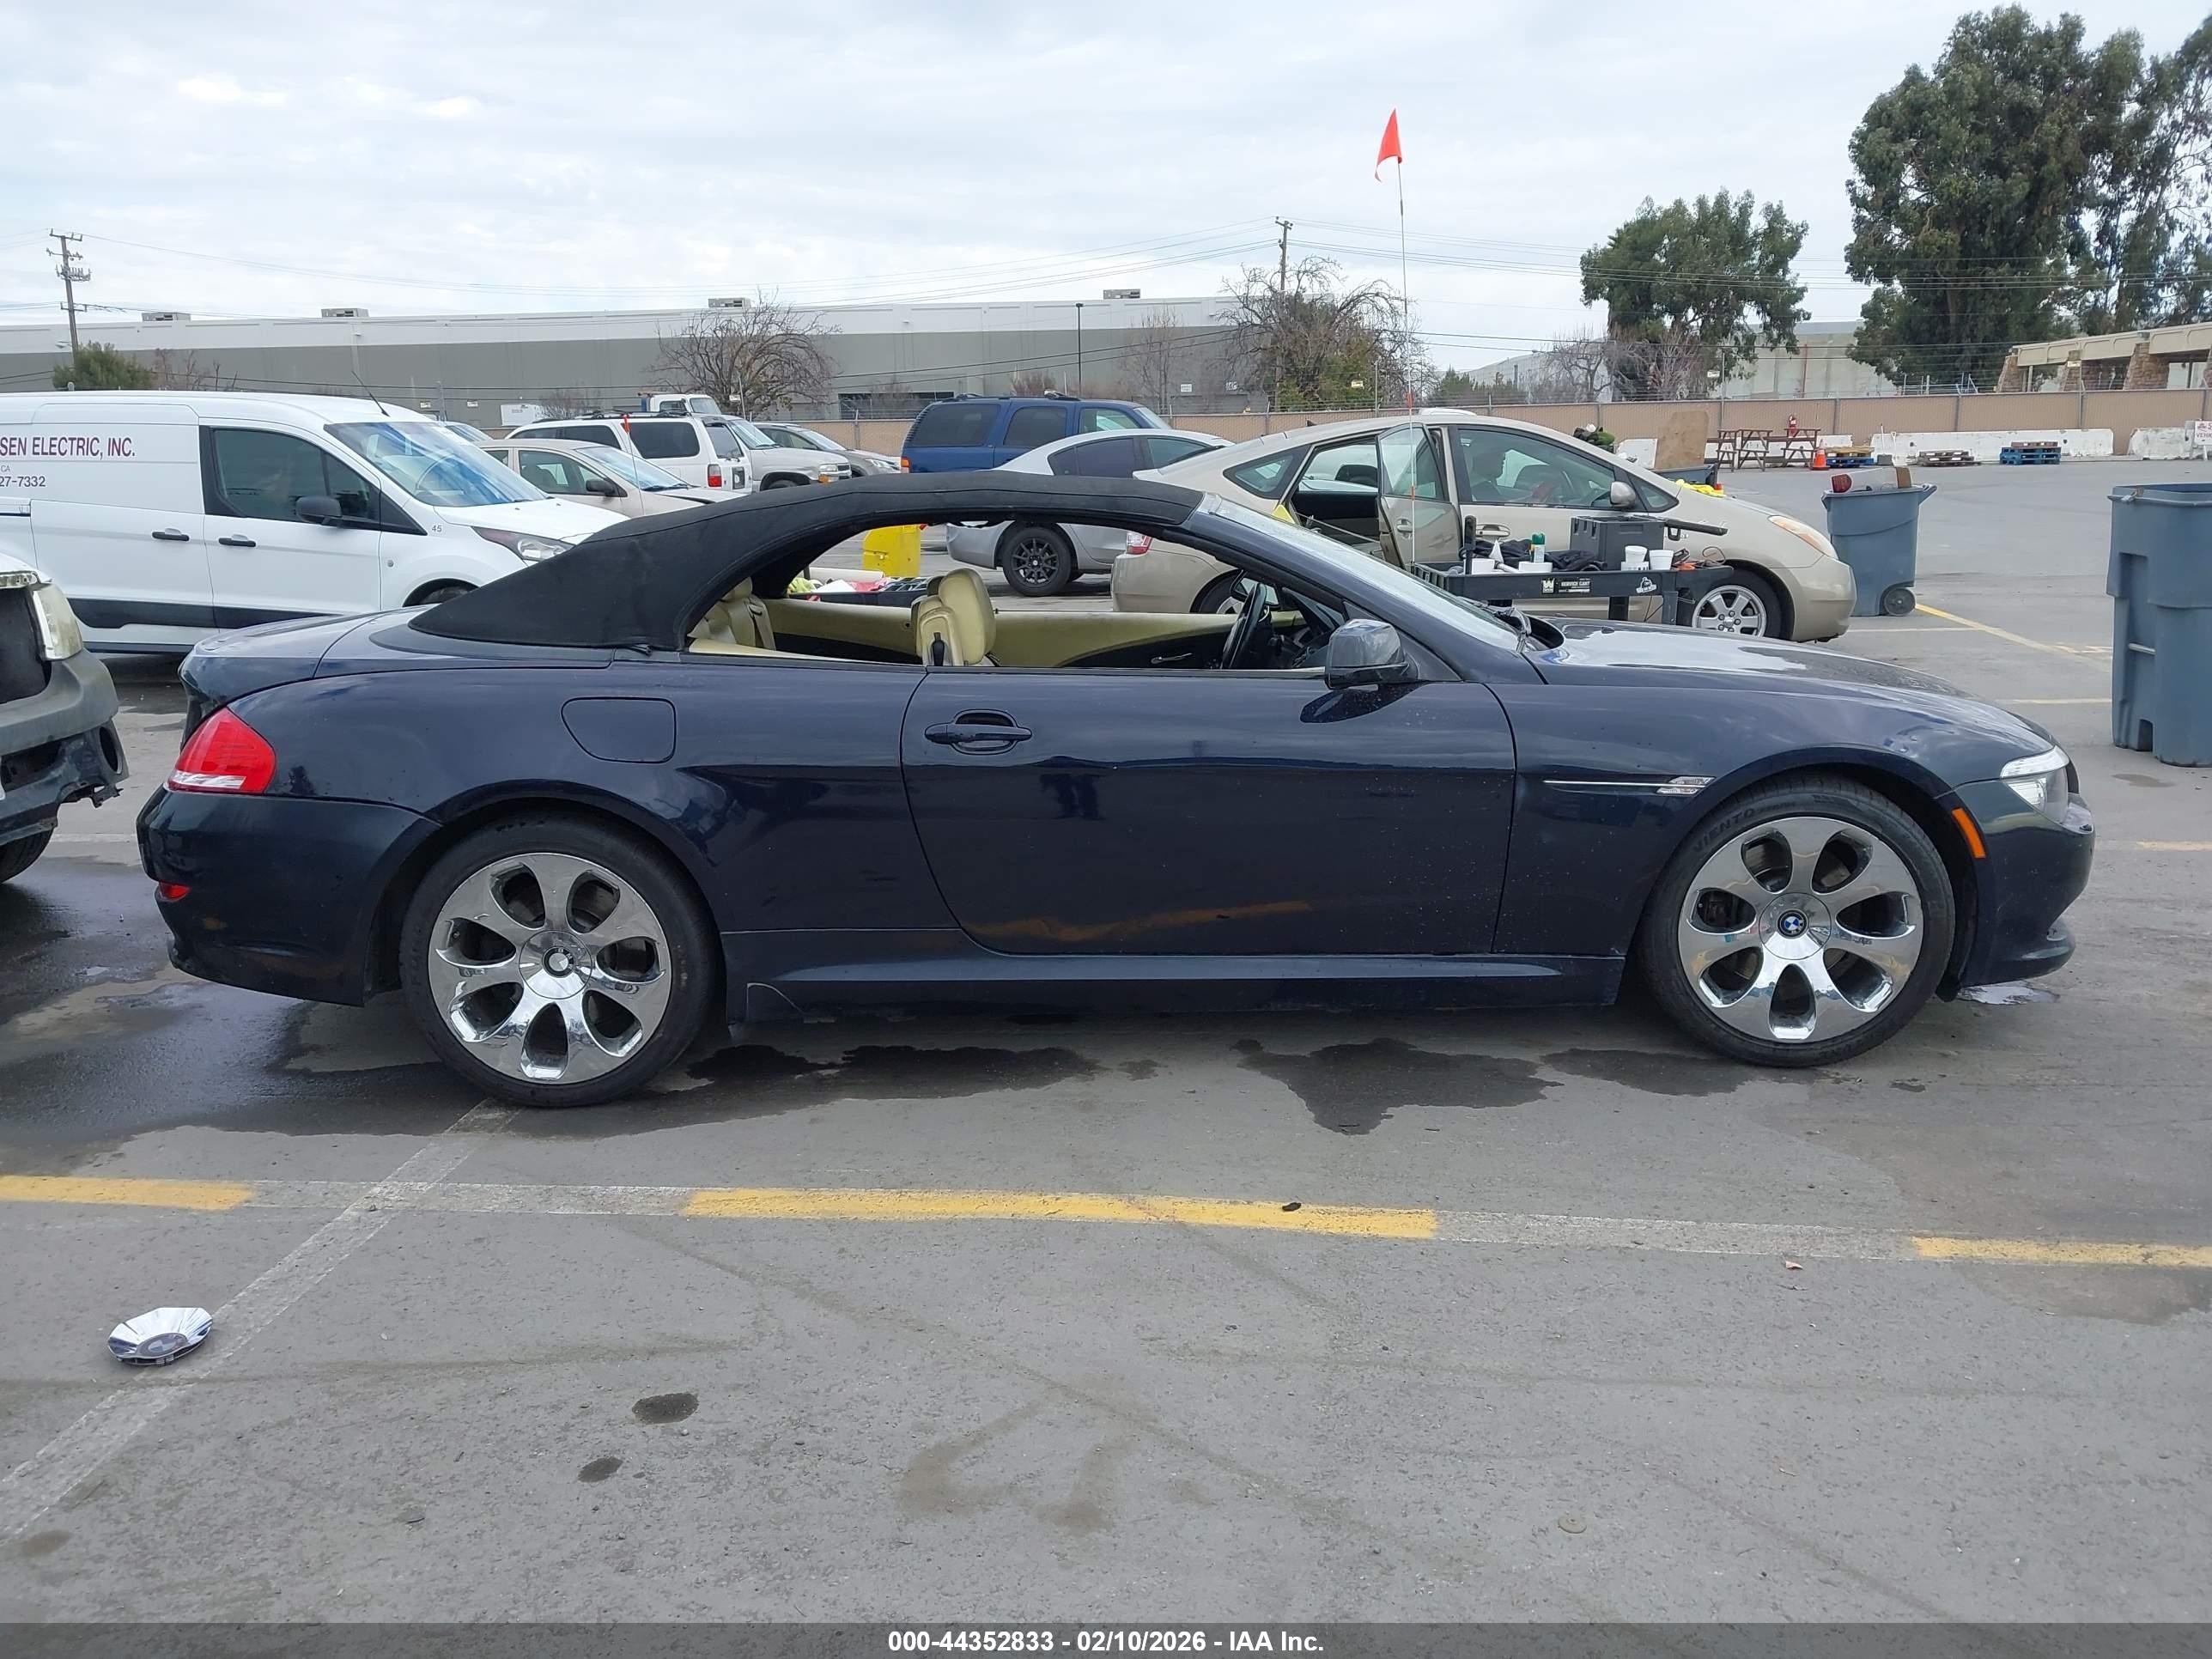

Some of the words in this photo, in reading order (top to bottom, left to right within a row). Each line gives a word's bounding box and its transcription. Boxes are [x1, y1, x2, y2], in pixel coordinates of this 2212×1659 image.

[0, 436, 27, 457] SEN
[32, 436, 104, 460] ELECTRIC,
[107, 437, 136, 457] INC.
[1, 465, 10, 473] CA
